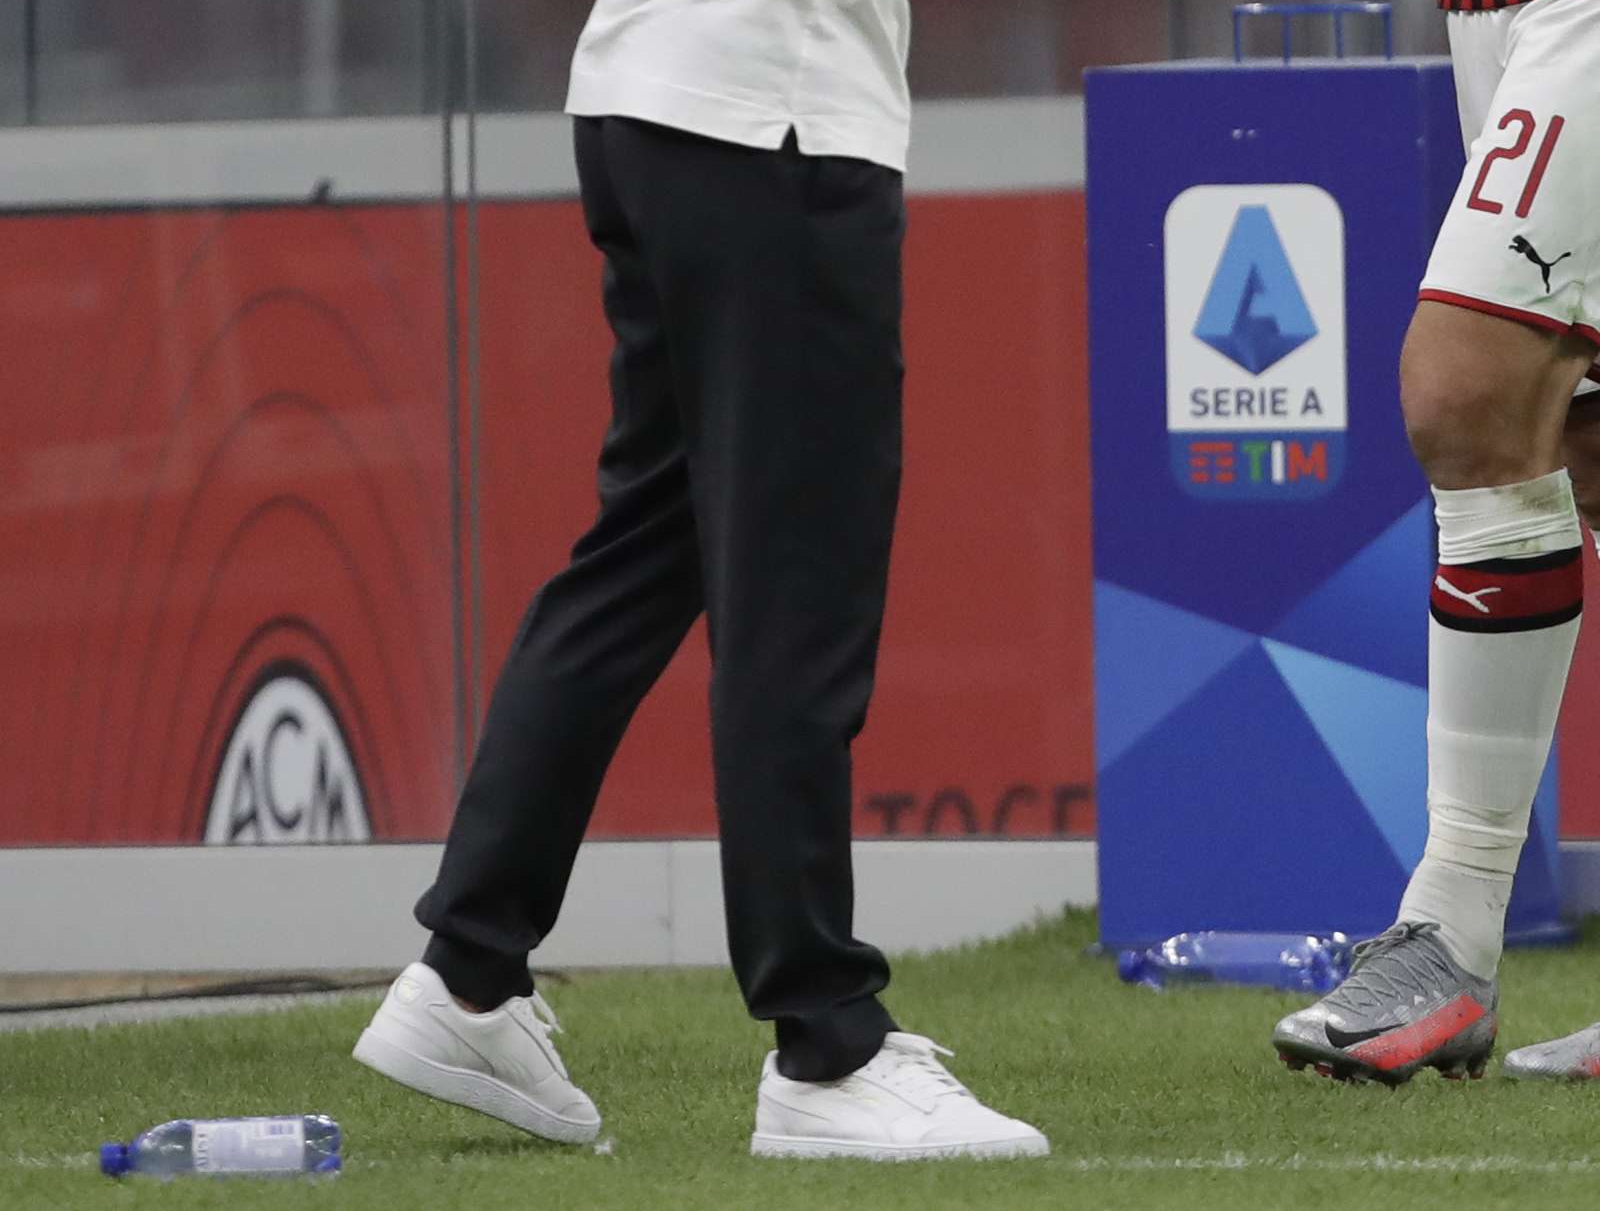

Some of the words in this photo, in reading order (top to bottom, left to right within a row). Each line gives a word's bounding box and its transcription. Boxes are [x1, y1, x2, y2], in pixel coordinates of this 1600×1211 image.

[1466, 108, 1565, 219] 21
[1190, 388, 1288, 417] SERIE
[1301, 389, 1323, 416] A
